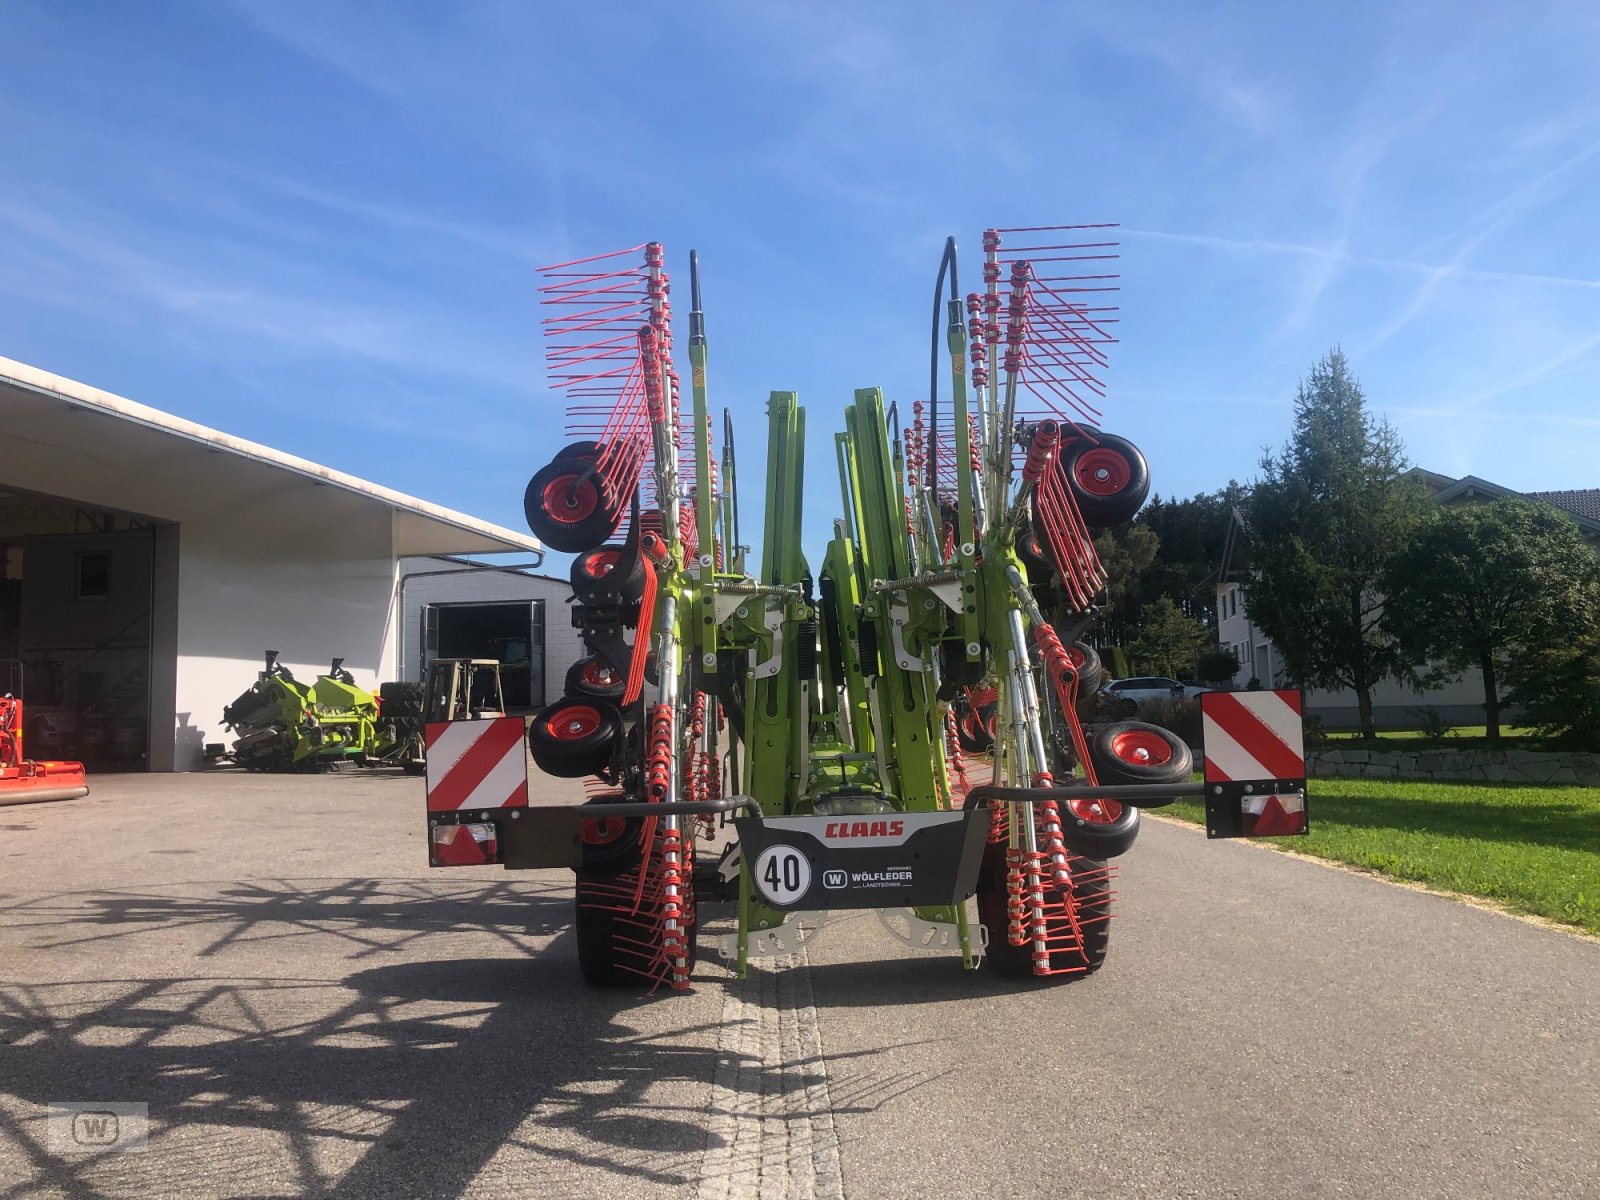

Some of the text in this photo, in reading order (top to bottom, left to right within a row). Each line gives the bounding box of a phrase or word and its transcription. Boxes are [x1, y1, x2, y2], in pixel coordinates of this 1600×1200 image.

[825, 820, 904, 838] CLAAS
[764, 854, 800, 892] 40
[829, 874, 842, 885] W
[852, 871, 912, 882] WÖLFLEDER
